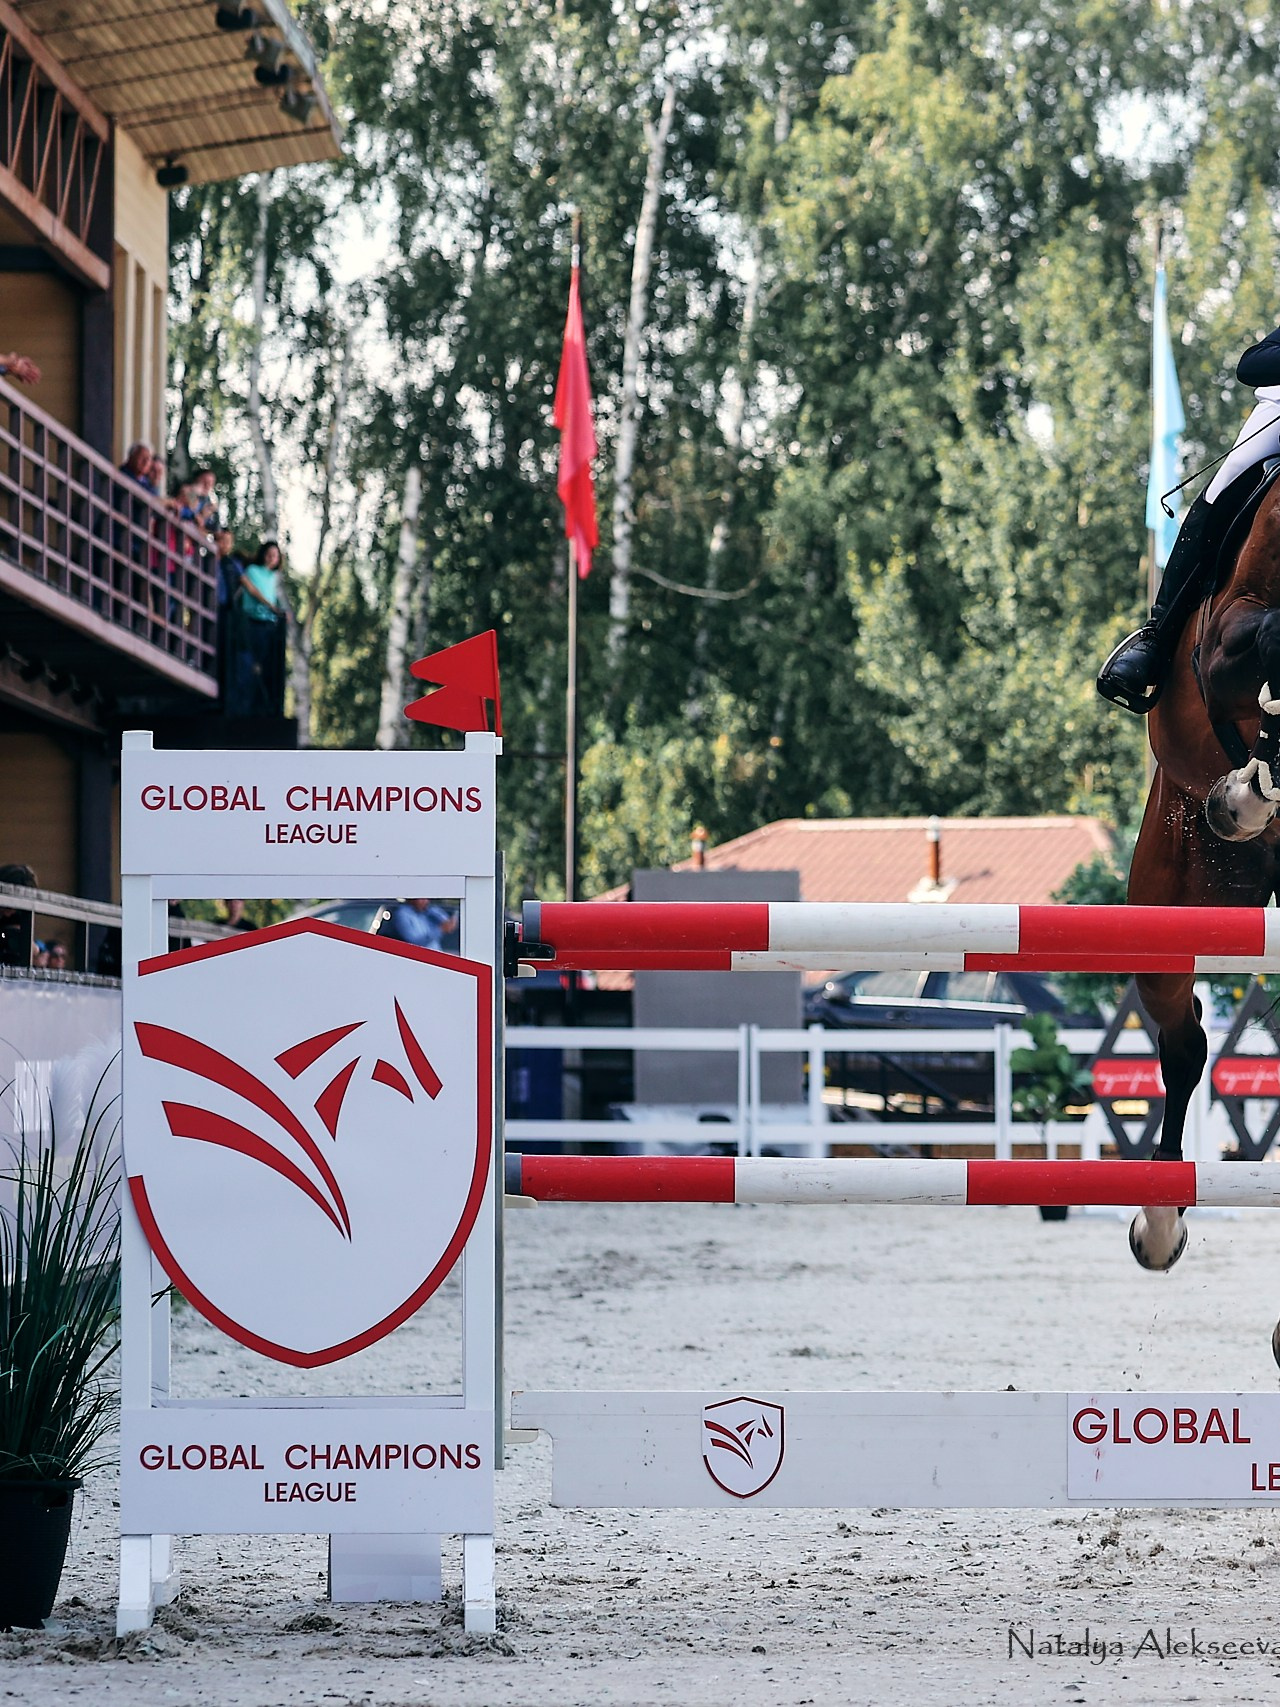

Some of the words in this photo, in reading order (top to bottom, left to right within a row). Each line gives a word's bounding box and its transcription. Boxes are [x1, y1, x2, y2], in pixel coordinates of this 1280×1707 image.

[140, 784, 266, 812] GLOBAL
[285, 785, 482, 813] CHAMPIONS
[265, 823, 358, 844] LEAGUE
[1073, 1407, 1251, 1445] GLOBAL
[139, 1444, 265, 1471] GLOBAL
[284, 1443, 481, 1470] CHAMPIONS
[264, 1482, 357, 1503] LEAGUE
